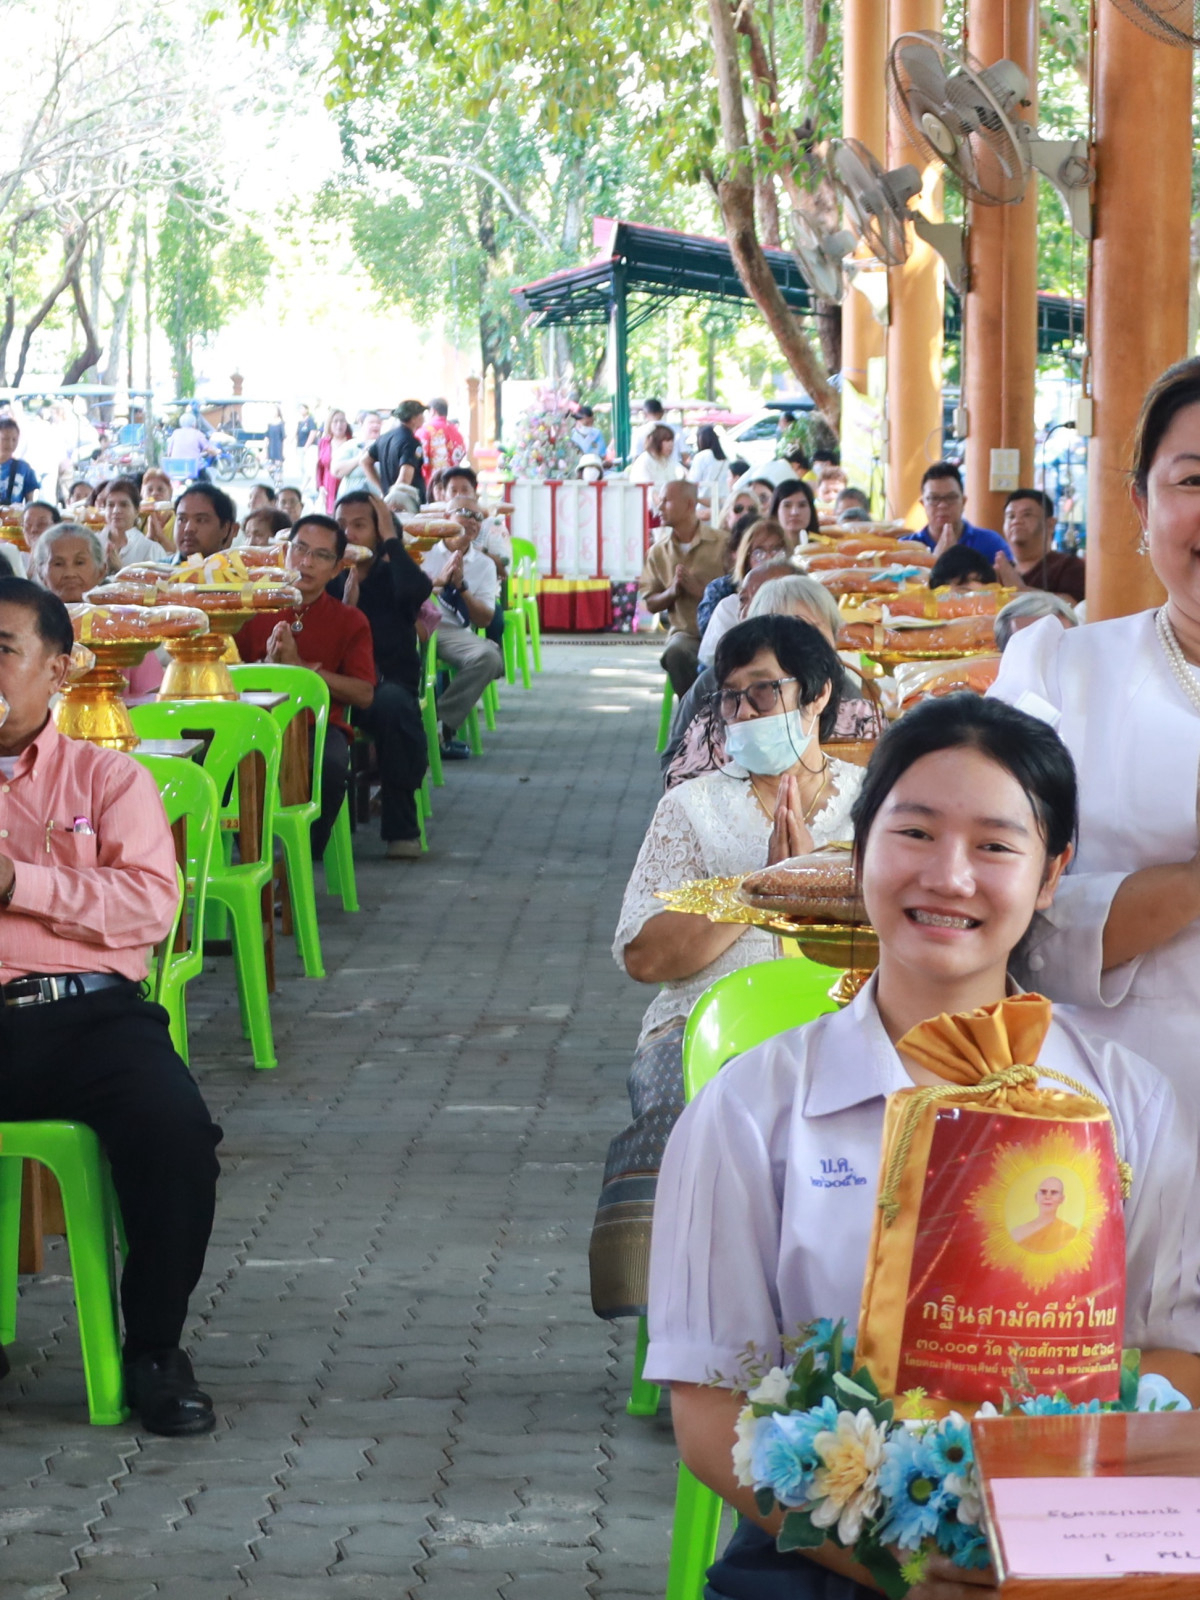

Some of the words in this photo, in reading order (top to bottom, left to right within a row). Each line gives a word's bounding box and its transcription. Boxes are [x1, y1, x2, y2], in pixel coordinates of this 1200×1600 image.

[819, 1158, 854, 1174] บ.ค.
[922, 1295, 1117, 1329] กฐินสามัคคีทั่วไทย
[983, 1339, 1002, 1356] วัด
[1115, 1530, 1185, 1539] 10,000
